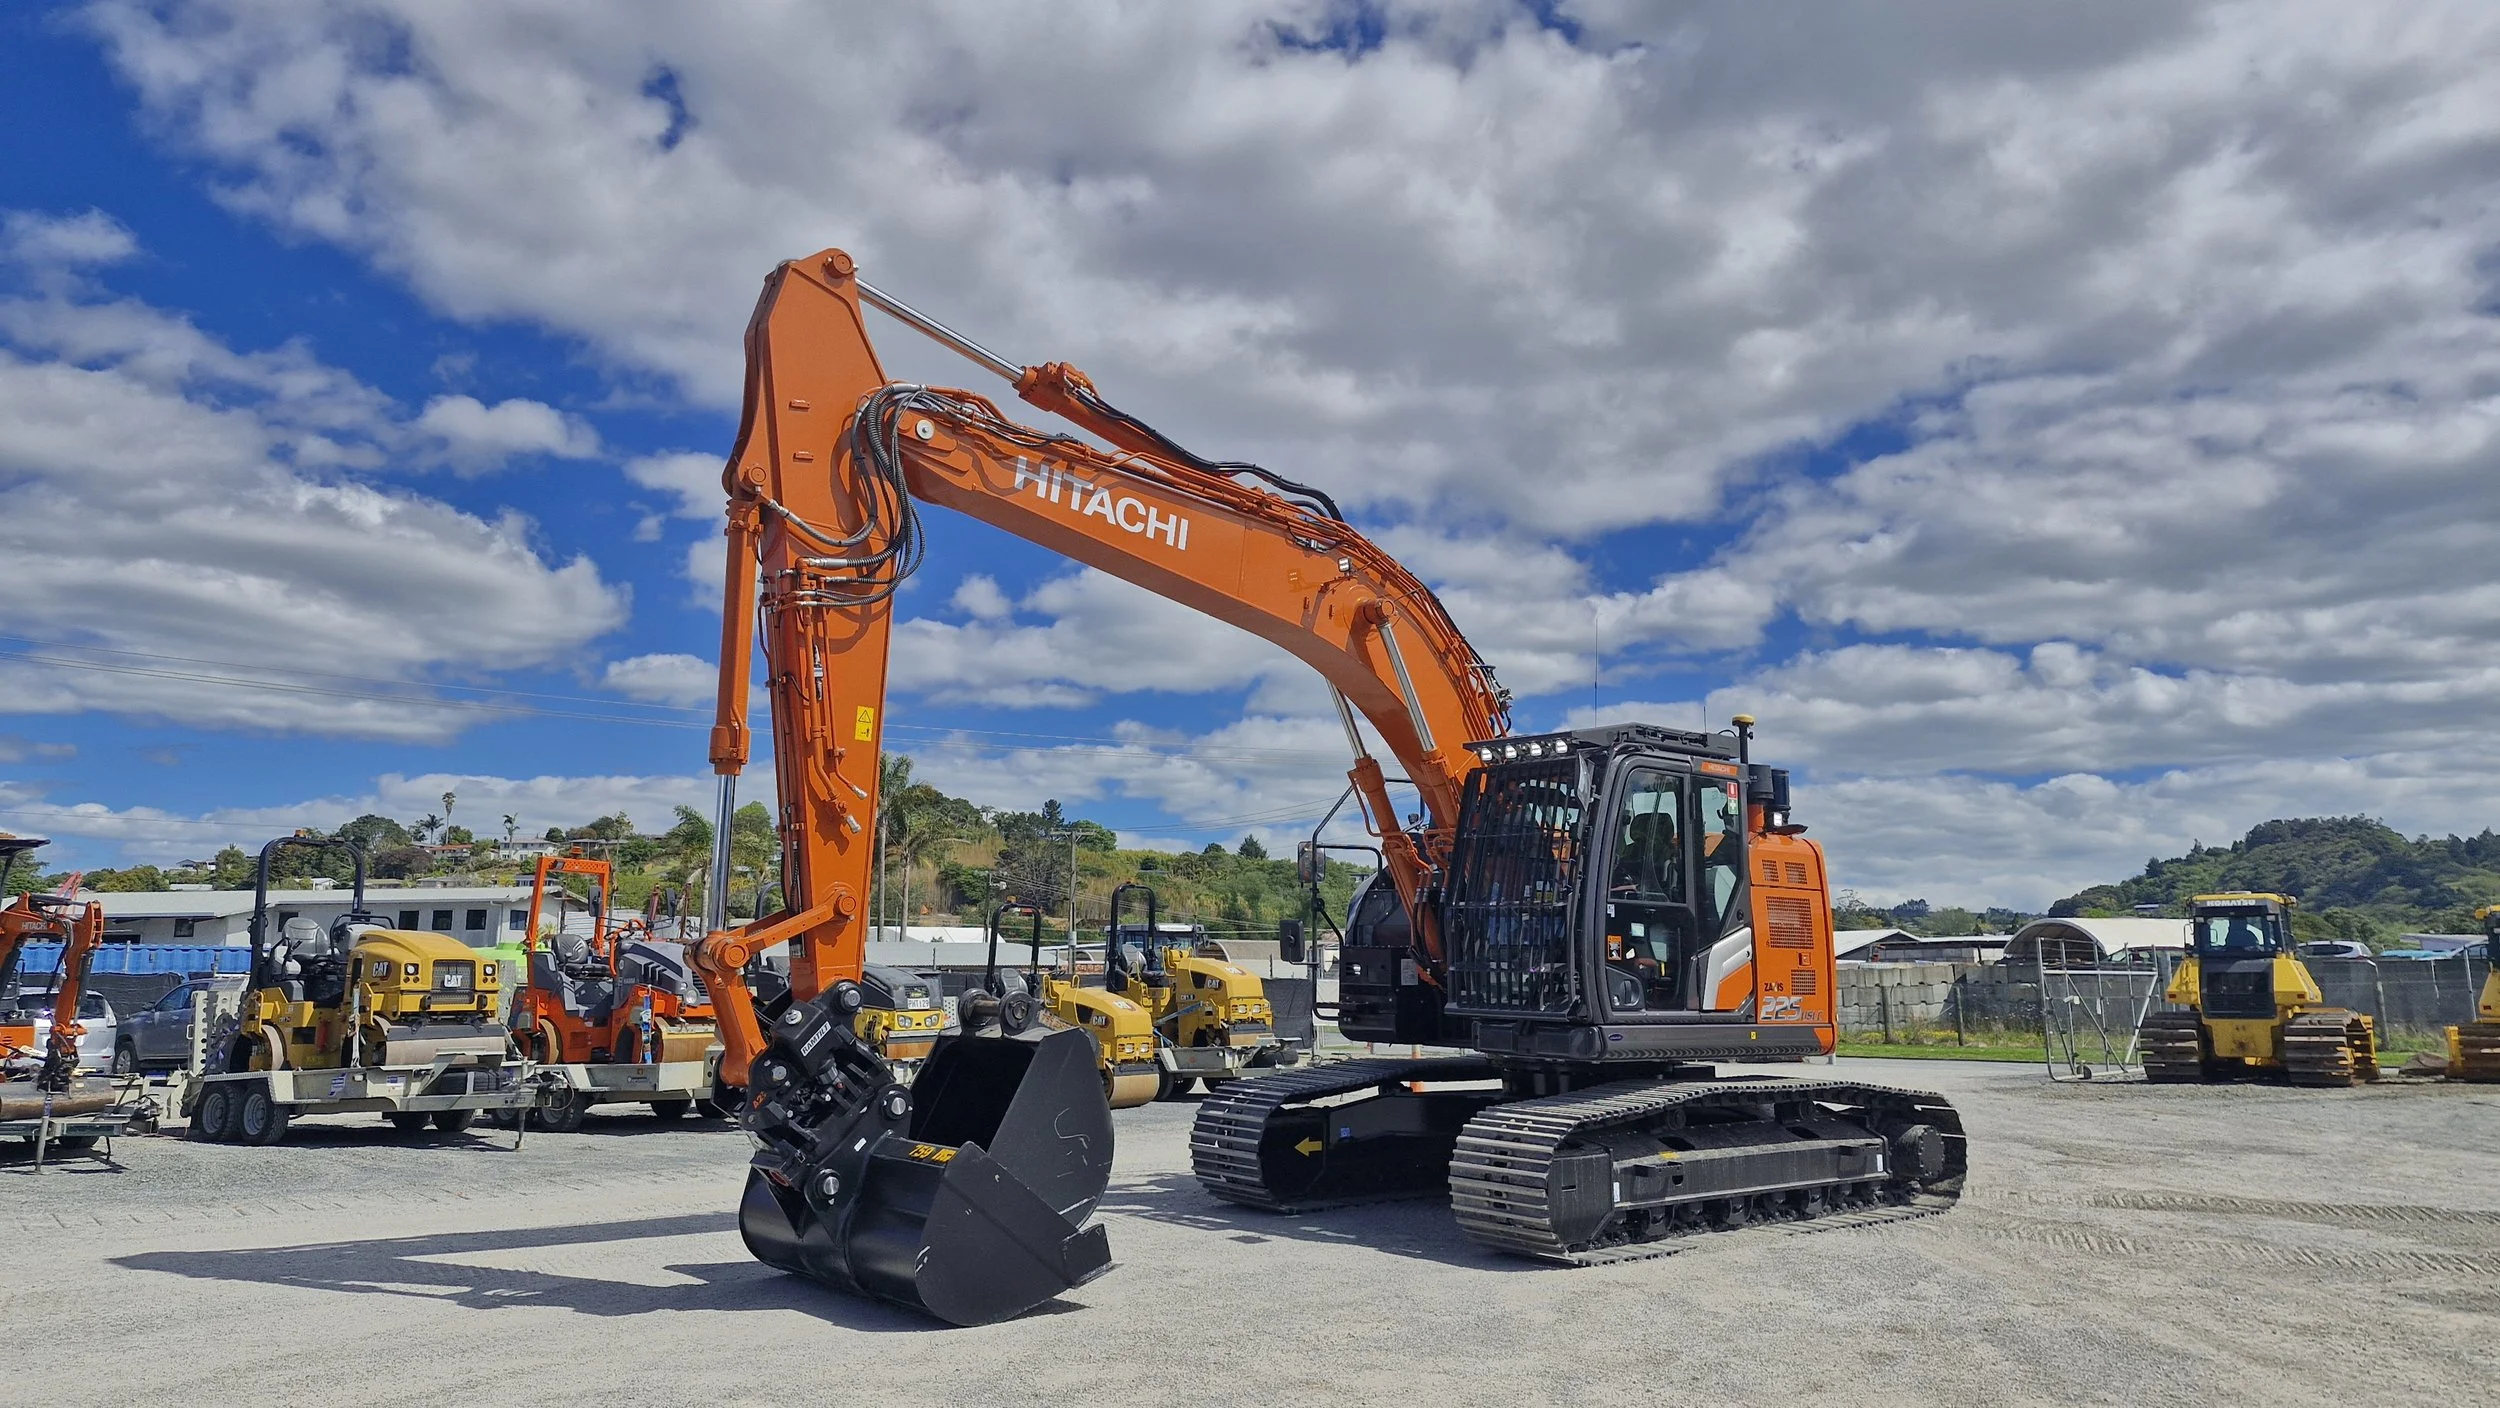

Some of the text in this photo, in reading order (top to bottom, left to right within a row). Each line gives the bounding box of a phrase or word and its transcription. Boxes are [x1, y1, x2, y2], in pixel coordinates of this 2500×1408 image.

[1014, 456, 1189, 551] HITACHI
[21, 921, 47, 930] HITACHI
[372, 962, 389, 976] CAT
[444, 974, 463, 988] CAT
[1207, 980, 1220, 988] CAT
[1761, 996, 1803, 1021] 225
[1092, 1015, 1107, 1026] CAT
[801, 1022, 830, 1055] RAMTILT
